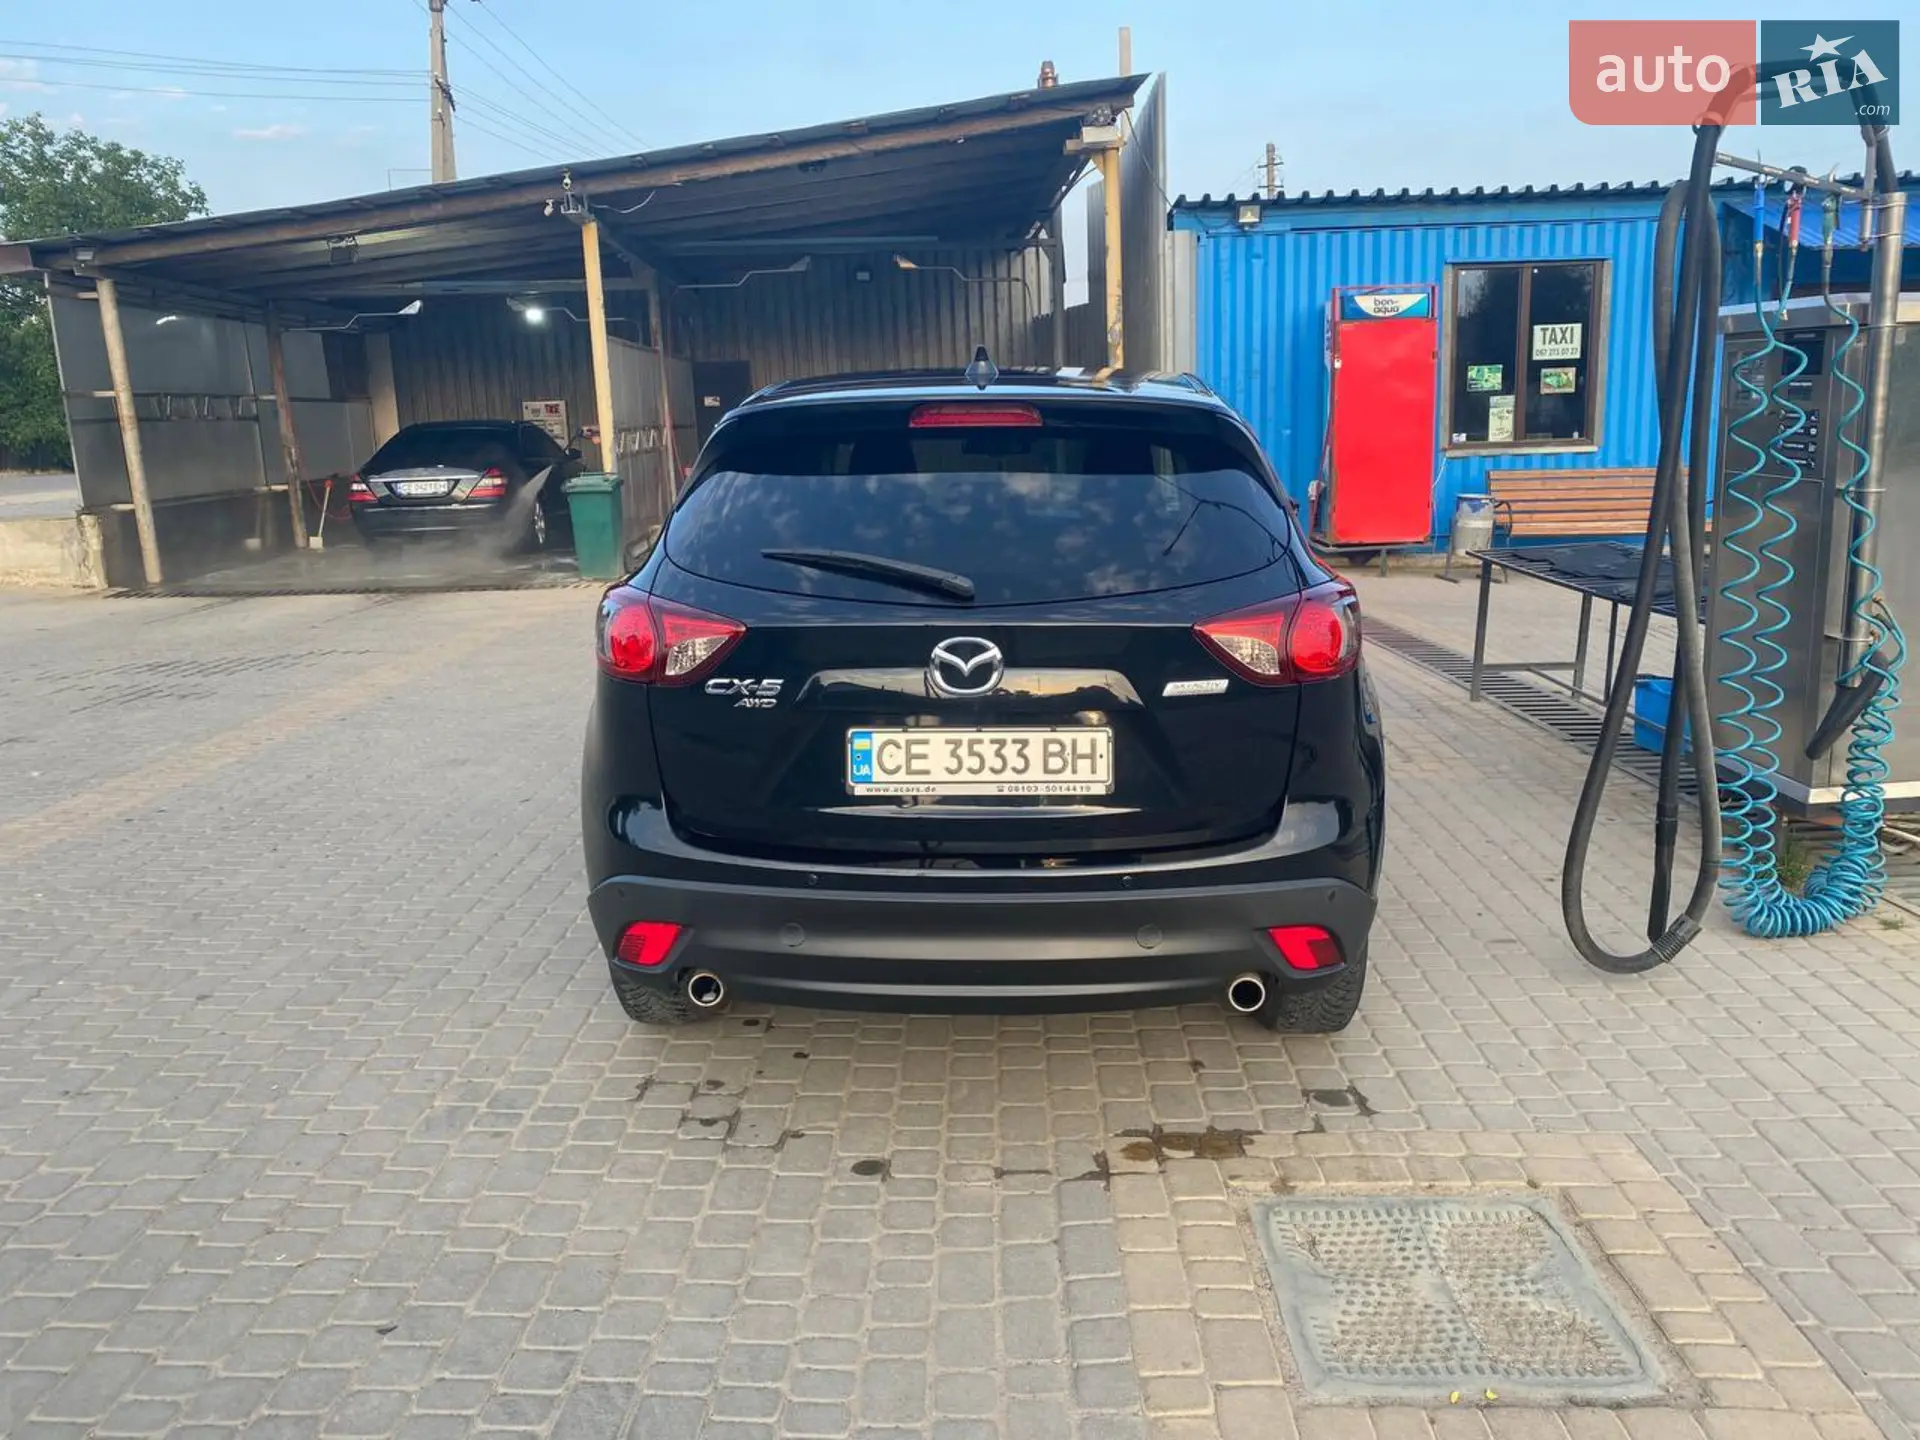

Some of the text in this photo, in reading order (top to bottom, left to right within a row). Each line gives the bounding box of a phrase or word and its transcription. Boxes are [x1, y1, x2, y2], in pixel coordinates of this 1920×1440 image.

[1540, 326, 1574, 345] TAXI
[705, 679, 784, 696] CX-5
[733, 698, 777, 708] AWD
[877, 738, 1097, 776] CE 3533 BH
[853, 764, 871, 776] UA
